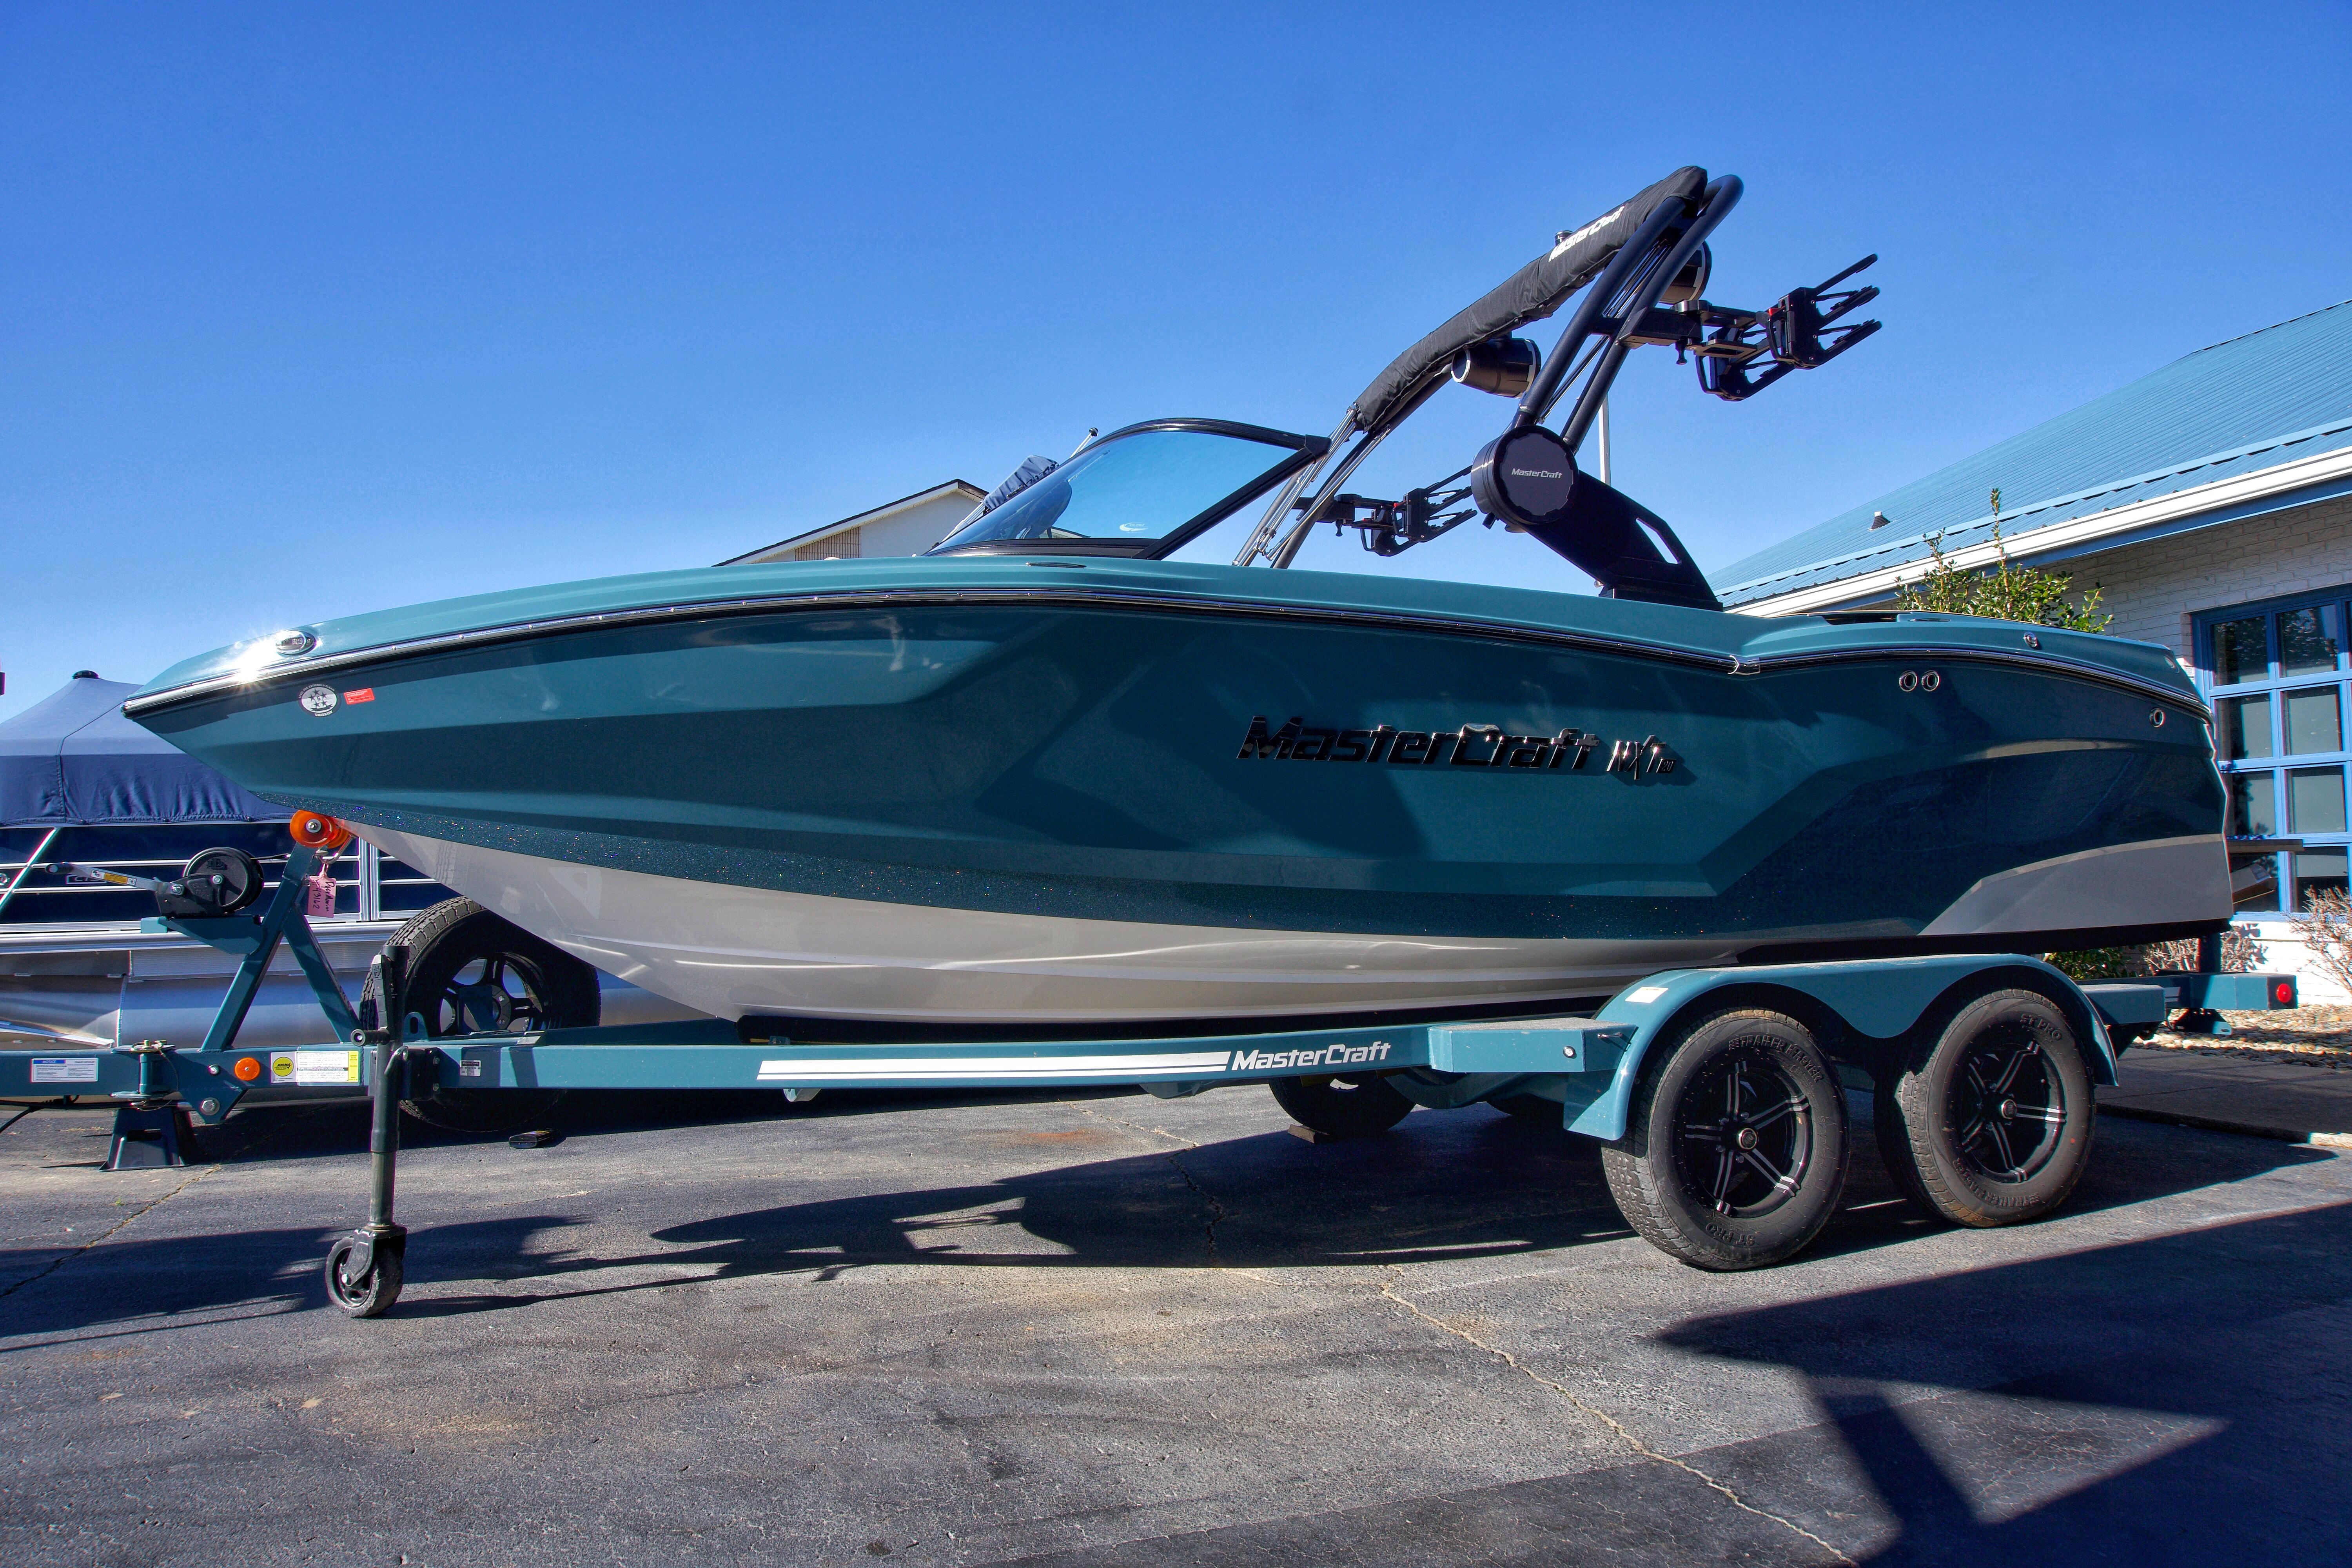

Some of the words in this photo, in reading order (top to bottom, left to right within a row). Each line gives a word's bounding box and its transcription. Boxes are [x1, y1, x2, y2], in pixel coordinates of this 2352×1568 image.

[1511, 468, 1562, 479] MasterCraft
[1236, 715, 1600, 769] MasterCraft
[1606, 735, 1666, 780] NXT
[1231, 1041, 1391, 1071] MasterCraft
[1705, 1222, 1734, 1243] PRO
